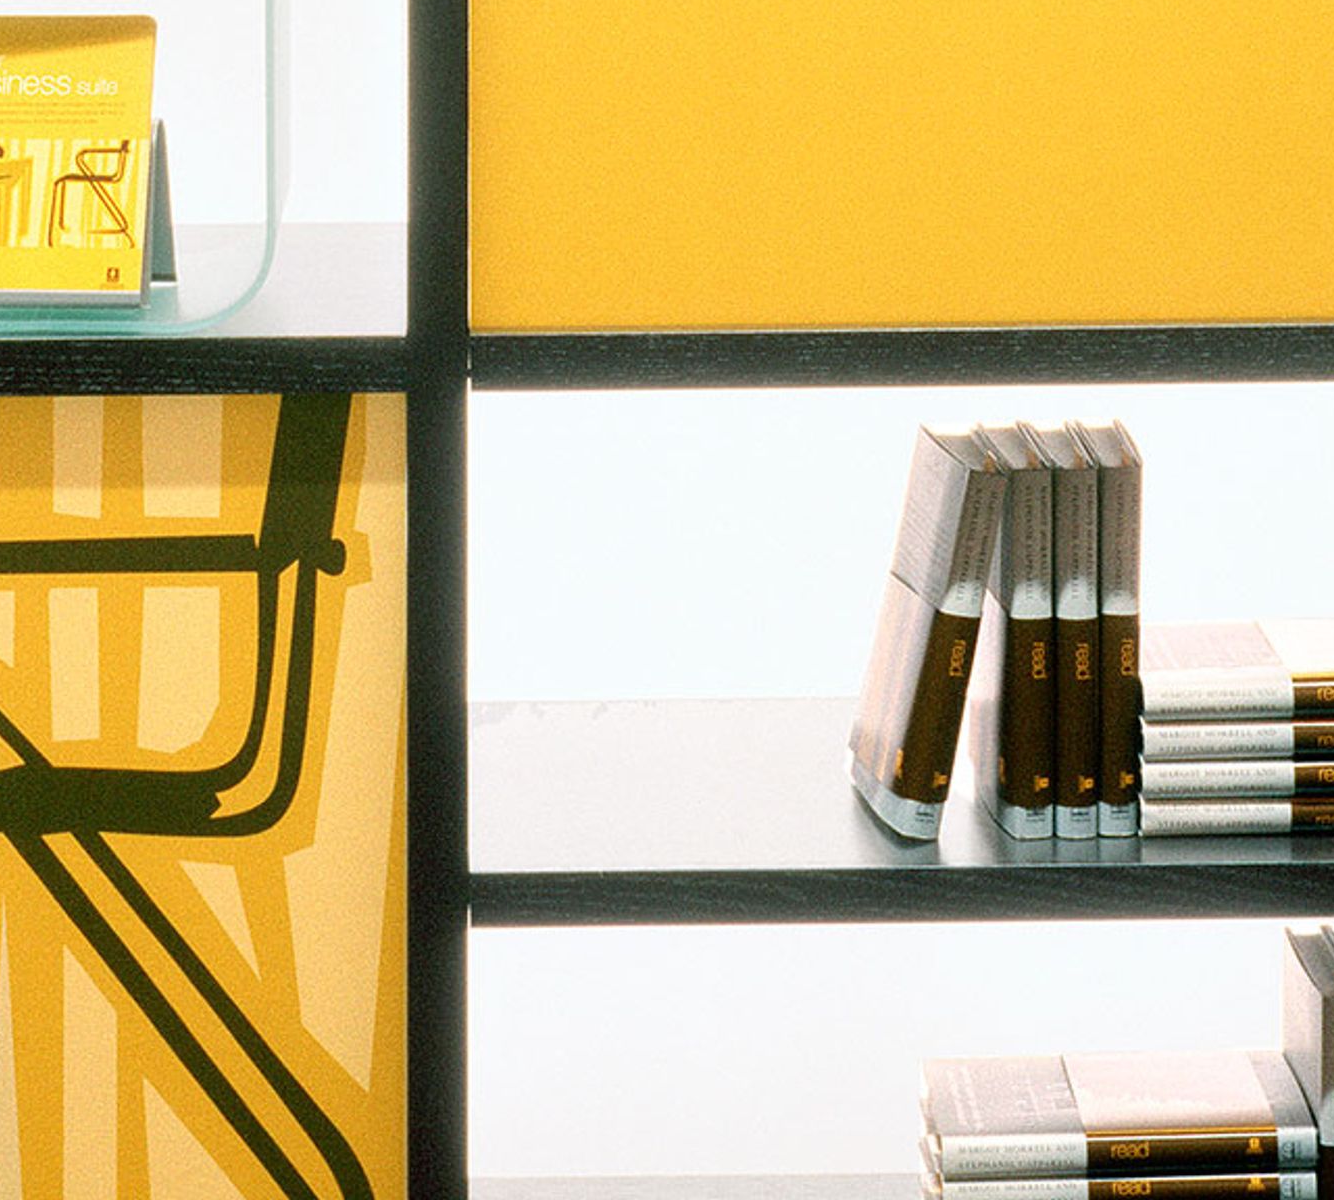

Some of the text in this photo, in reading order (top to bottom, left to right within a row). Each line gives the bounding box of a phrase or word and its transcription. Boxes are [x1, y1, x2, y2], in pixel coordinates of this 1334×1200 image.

[77, 79, 118, 96] suite
[949, 639, 965, 677] read
[1031, 641, 1047, 680] read
[1076, 643, 1091, 680] read
[1121, 637, 1134, 677] read
[1110, 1142, 1149, 1159] read
[1112, 1182, 1151, 1197] read
